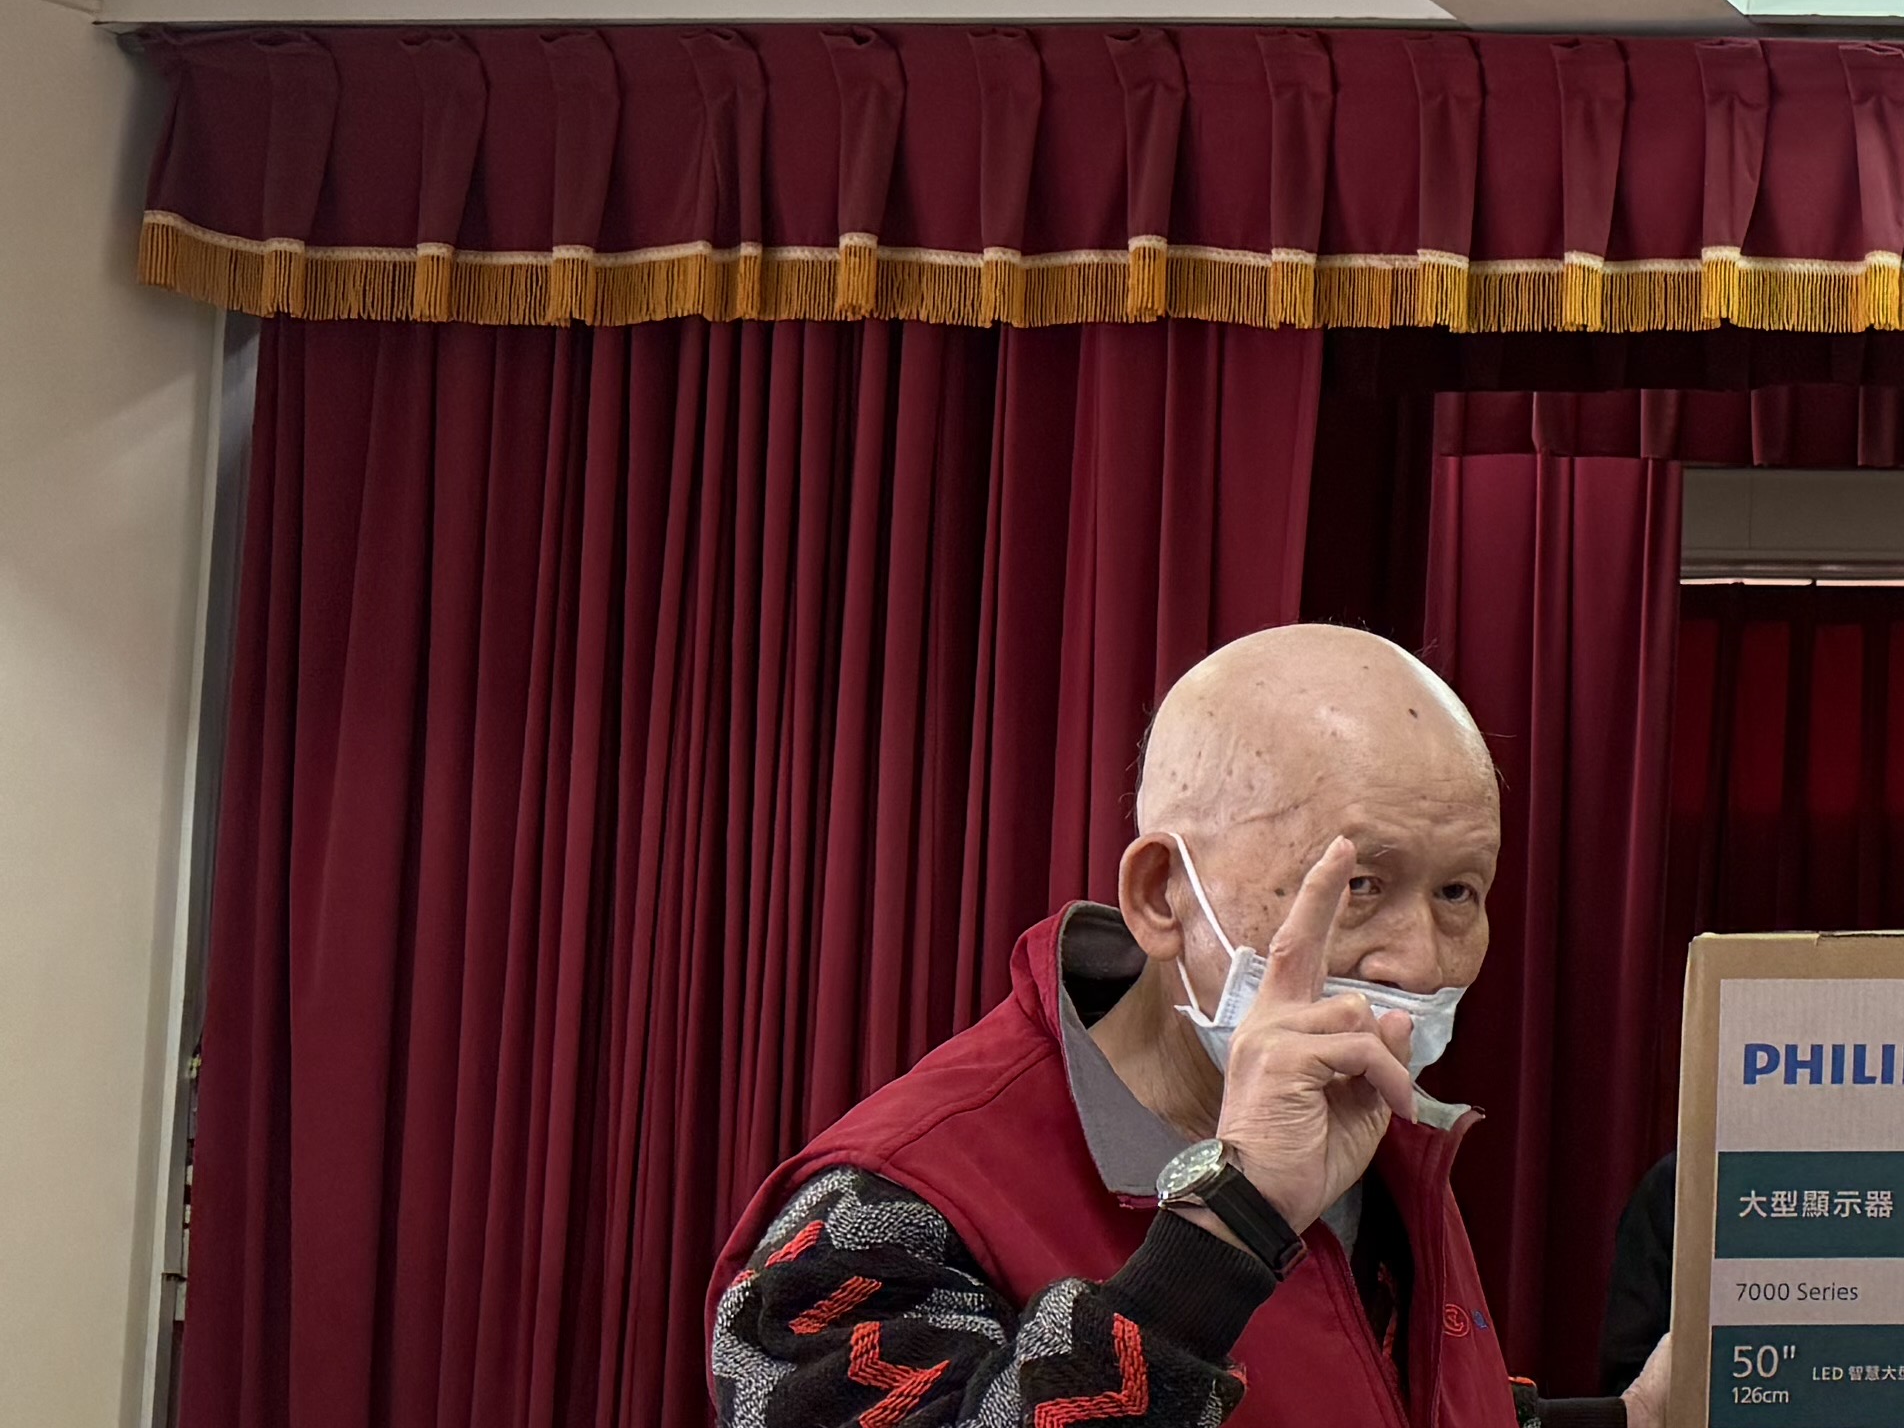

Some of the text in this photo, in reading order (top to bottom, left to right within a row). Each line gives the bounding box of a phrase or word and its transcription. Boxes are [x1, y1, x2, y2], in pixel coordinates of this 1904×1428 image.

[1738, 1189, 1895, 1220] 大型顯示器
[1736, 1281, 1860, 1303] 7000 Series
[1812, 1365, 1844, 1382] LED
[1731, 1386, 1790, 1405] 126cm
